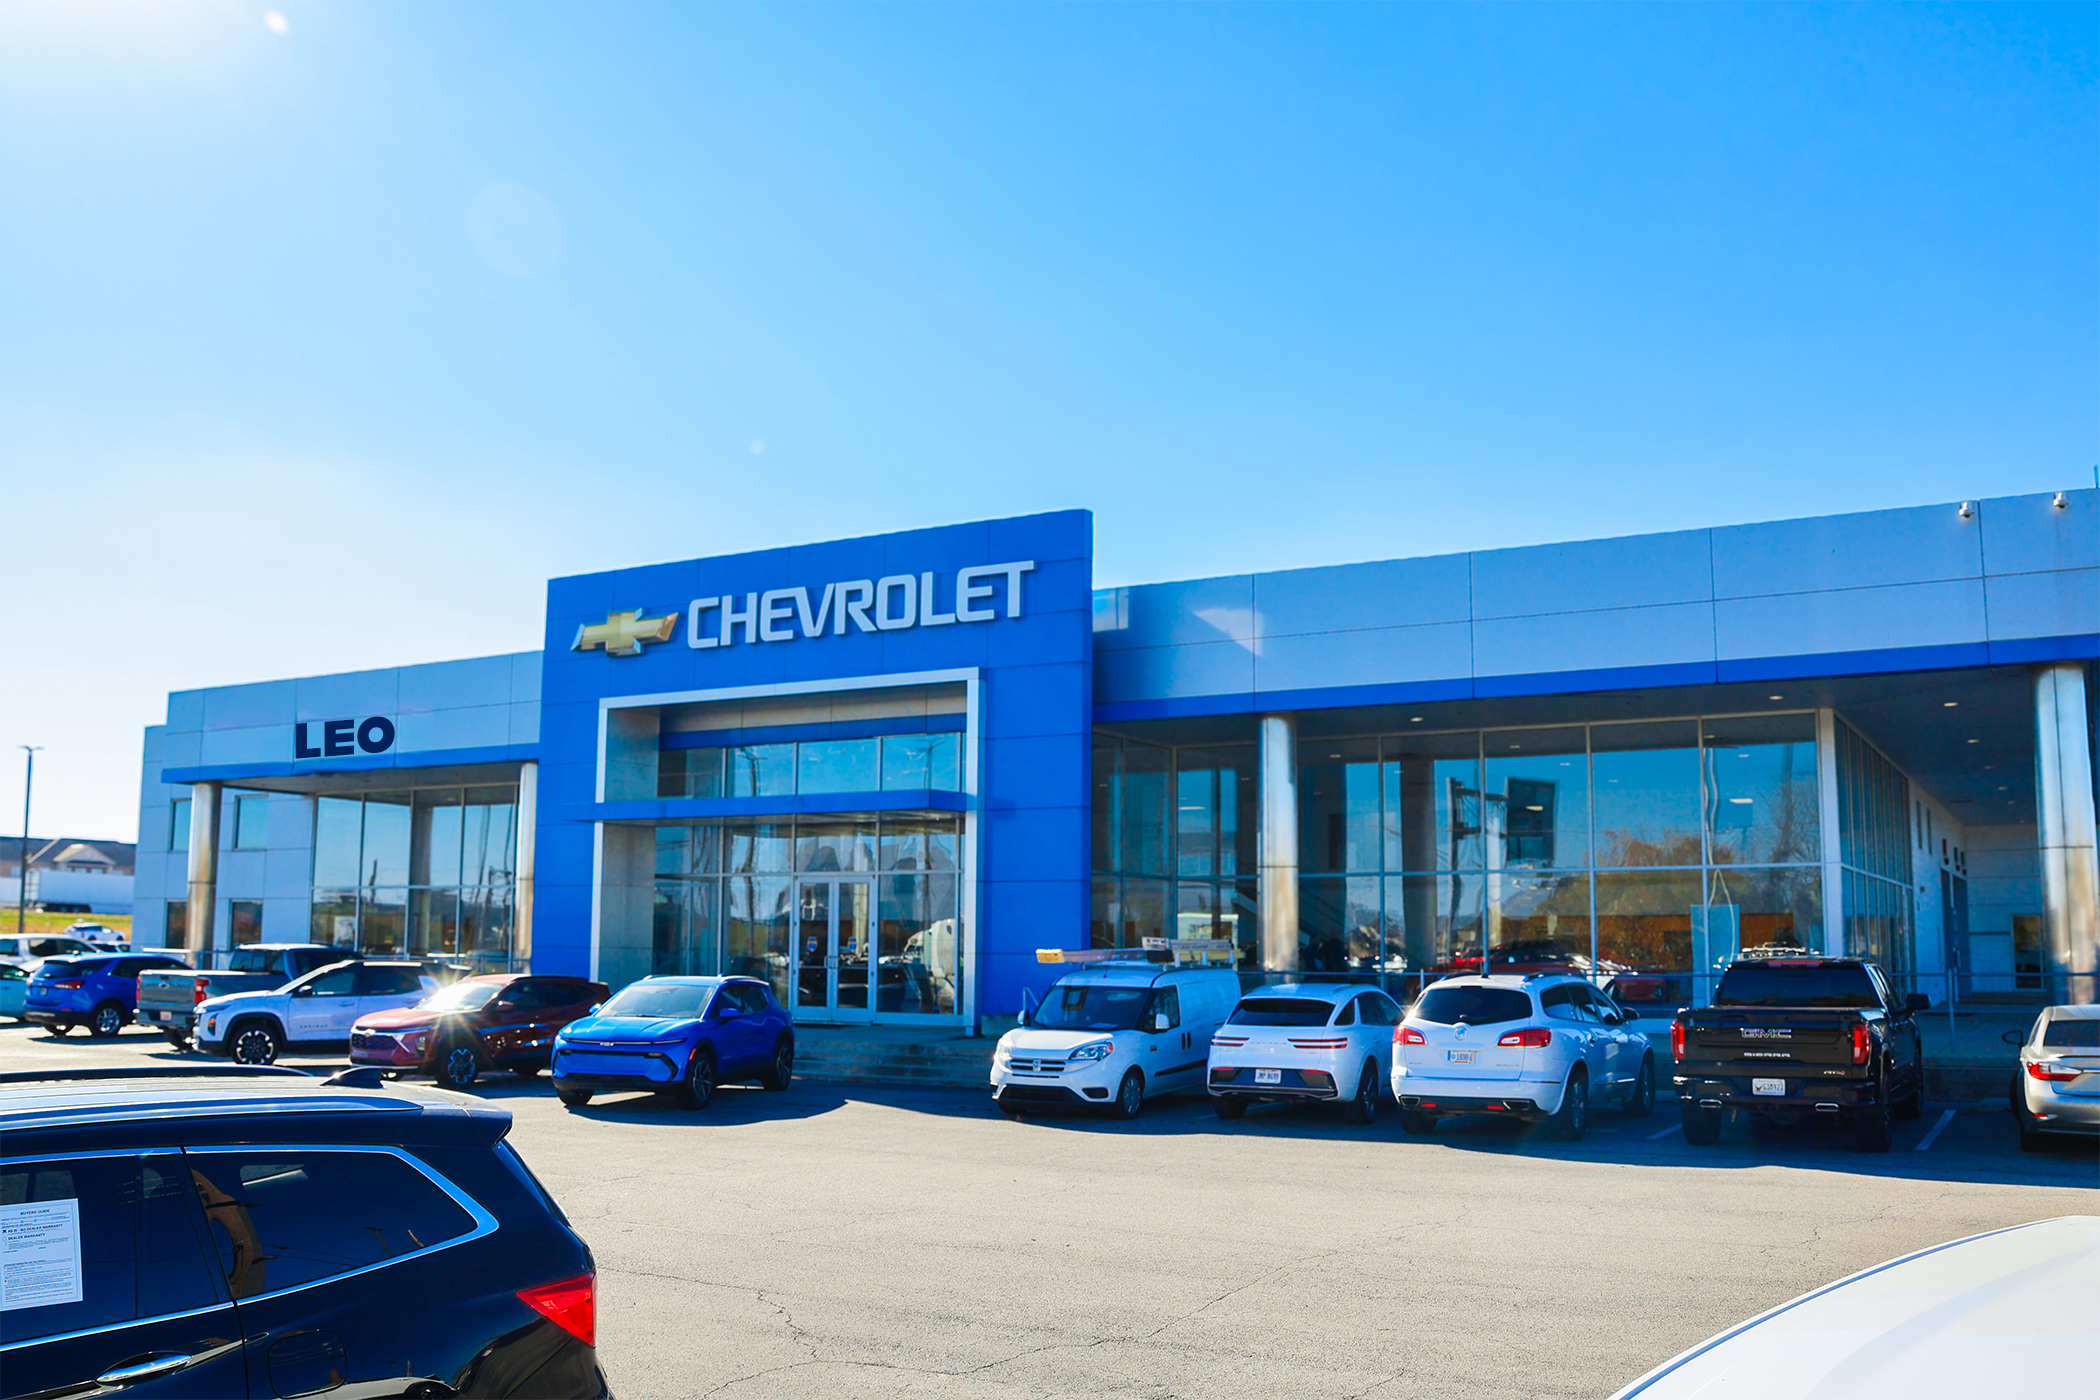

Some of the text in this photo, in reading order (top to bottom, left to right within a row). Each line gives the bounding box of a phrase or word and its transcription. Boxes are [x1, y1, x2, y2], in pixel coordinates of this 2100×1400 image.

[687, 560, 1035, 649] CHEVROLET
[295, 716, 395, 759] LEO
[1740, 1028, 1792, 1038] GMC
